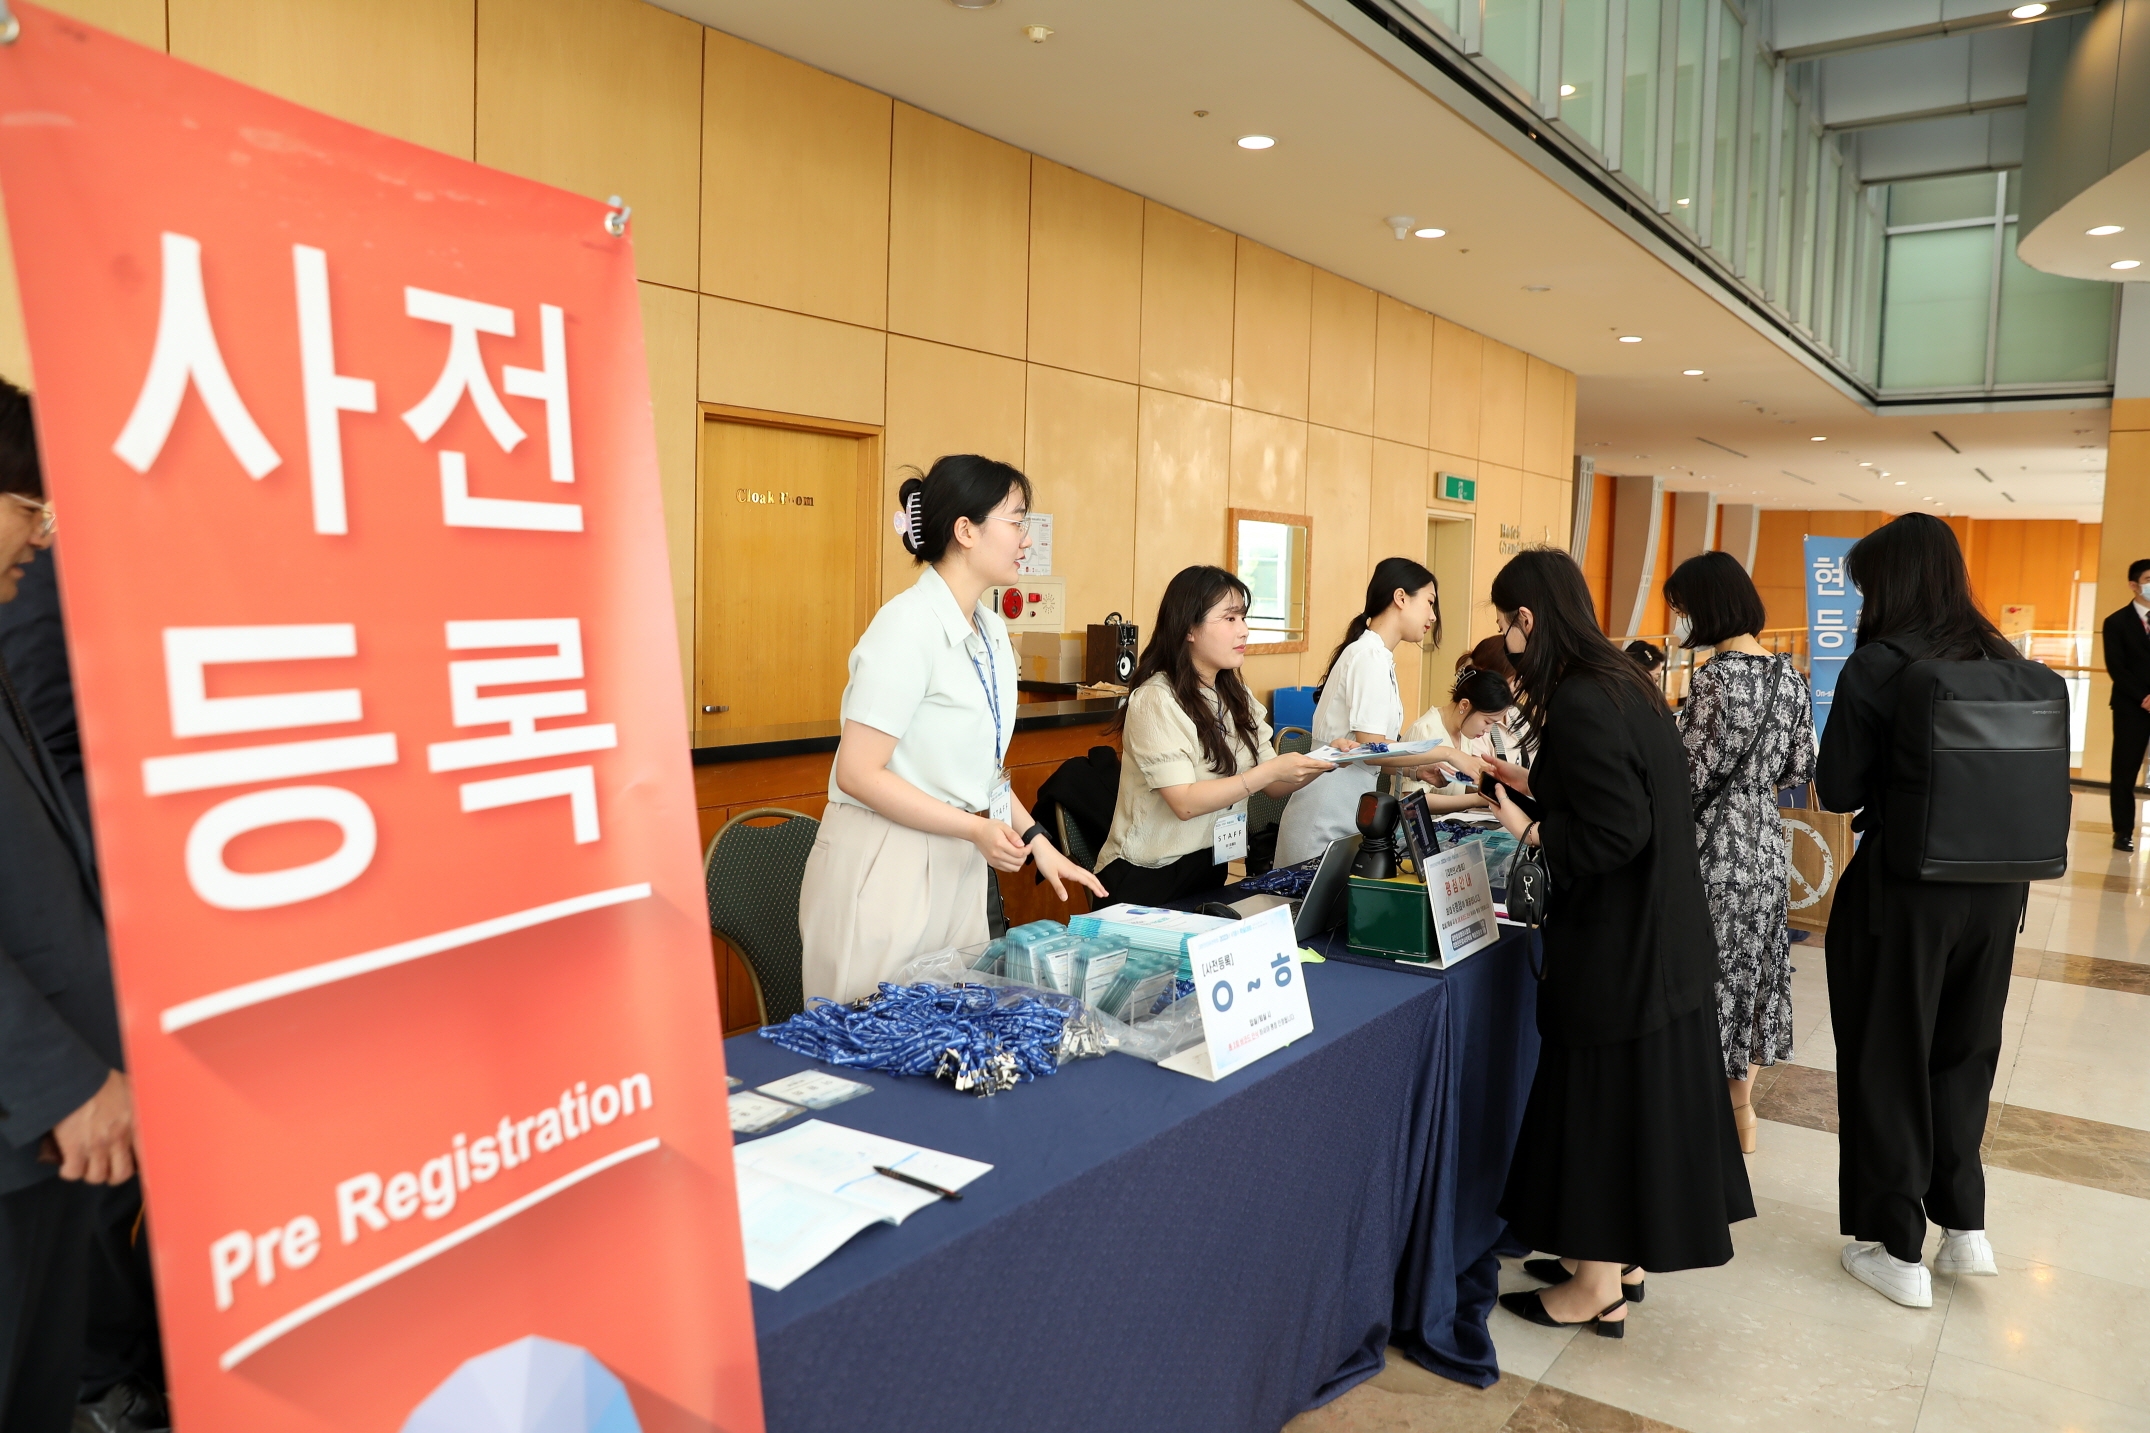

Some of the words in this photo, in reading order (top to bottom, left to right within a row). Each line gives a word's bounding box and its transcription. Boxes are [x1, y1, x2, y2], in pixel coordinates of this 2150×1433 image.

[111, 231, 585, 535] 사전
[736, 488, 775, 504] Cloak
[779, 492, 814, 507] Rom
[1500, 523, 1521, 539] Hotel
[1813, 557, 1863, 597] 현
[1814, 609, 1862, 649] 등
[1815, 689, 1834, 698] On-si
[142, 617, 619, 911] 등록
[992, 803, 1009, 819] STAFF
[1217, 829, 1242, 842] STAFF
[1201, 953, 1235, 977] [사전등록]
[1270, 952, 1292, 988] ㅎ
[210, 1215, 320, 1310] Pre
[336, 1072, 654, 1243] Registration
